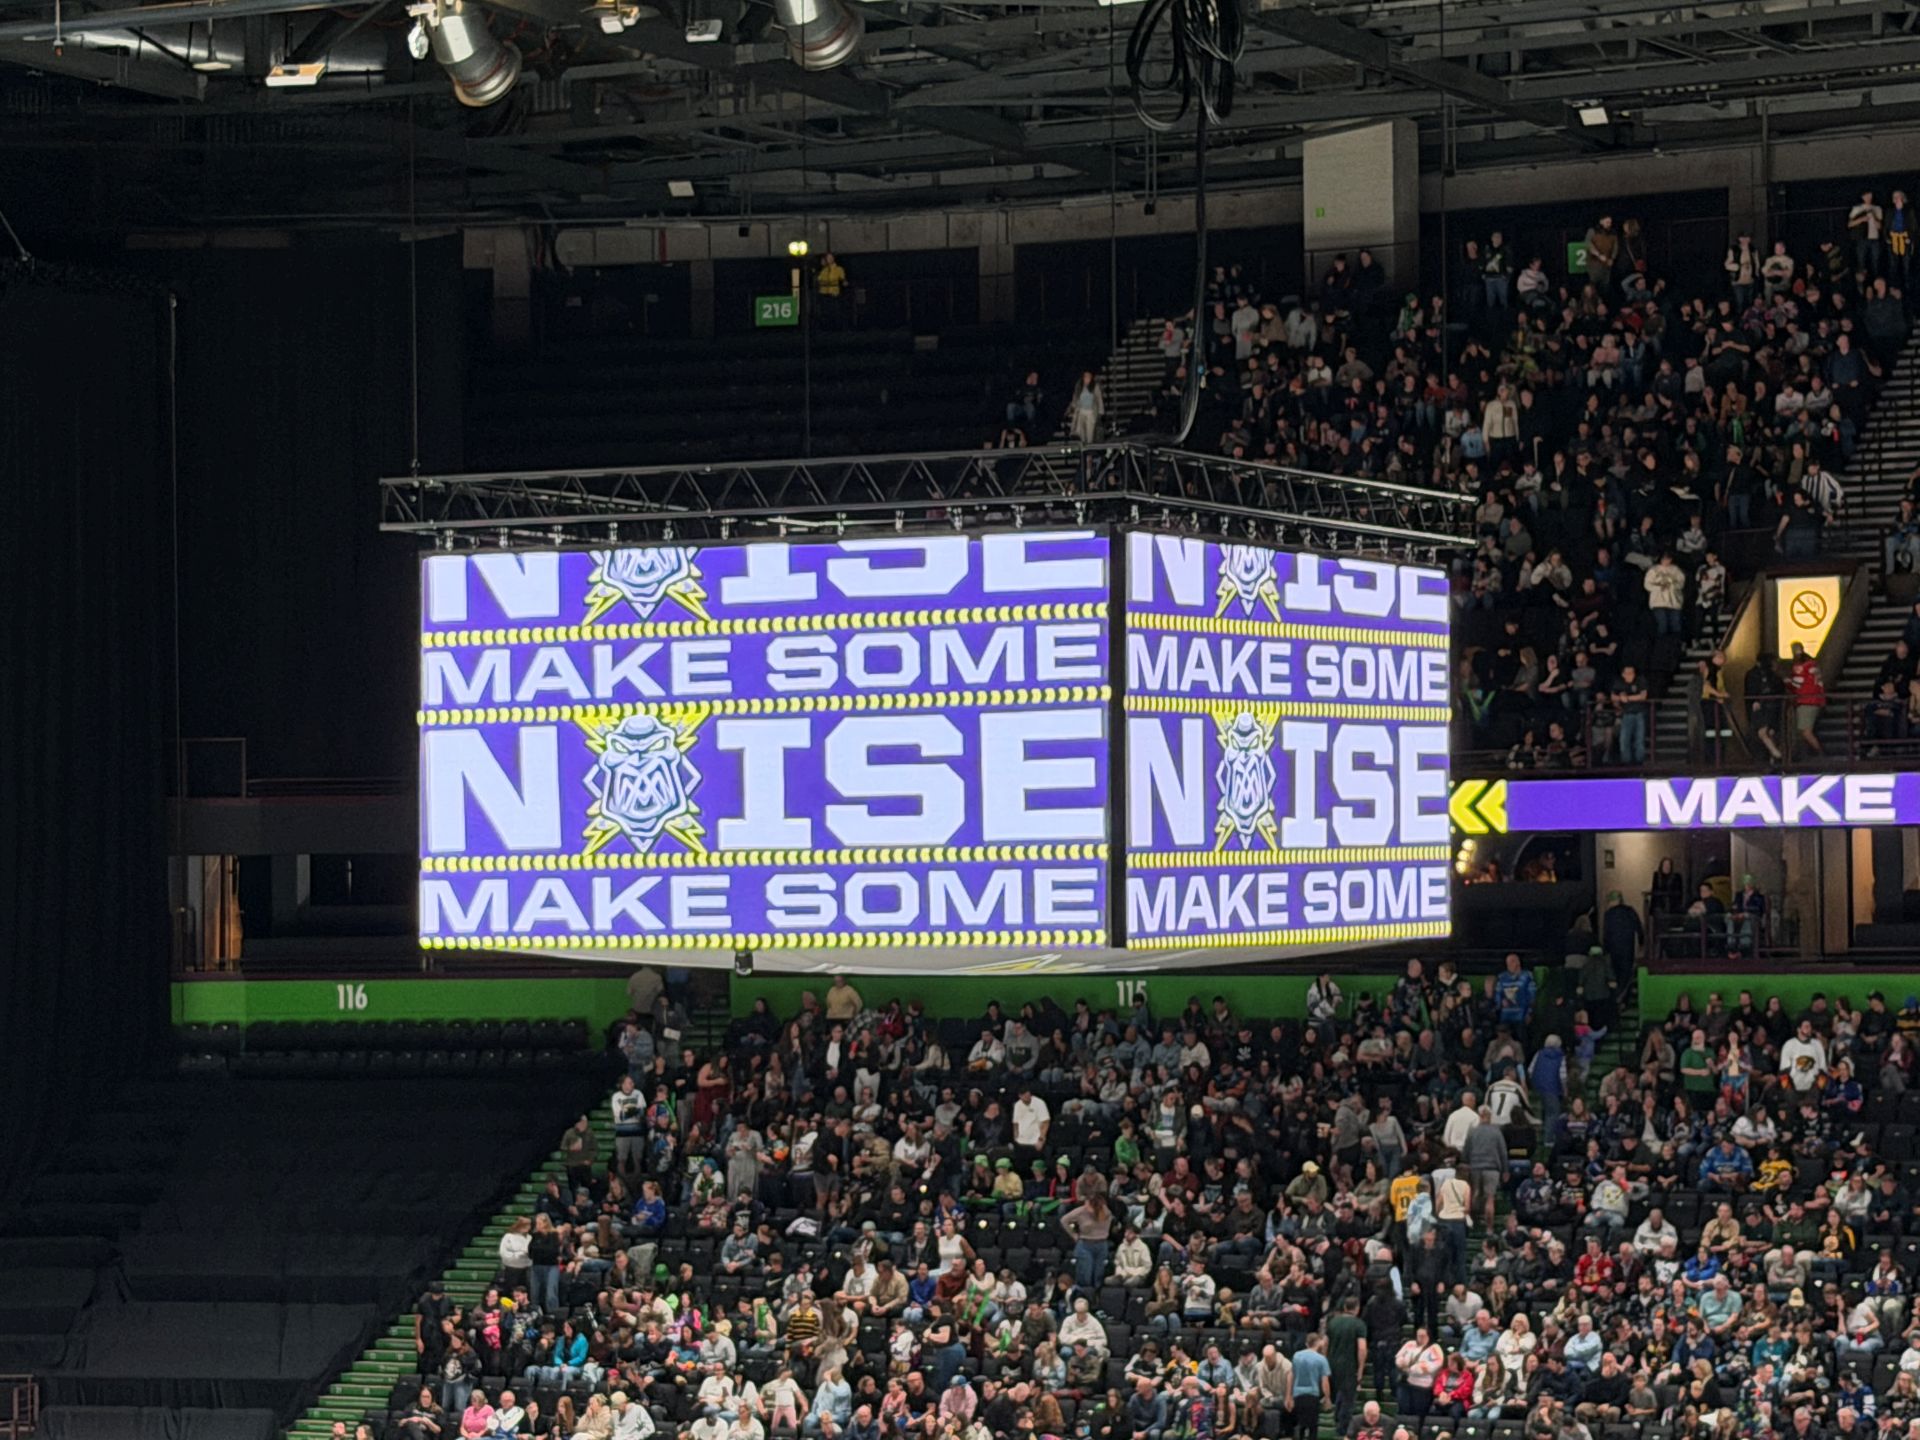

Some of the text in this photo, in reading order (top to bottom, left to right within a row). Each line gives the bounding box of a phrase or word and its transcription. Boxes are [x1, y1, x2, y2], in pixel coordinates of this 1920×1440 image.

[762, 303, 792, 319] 216
[426, 624, 1100, 705] MAKE SOME
[1128, 634, 1448, 701] MAKE SOME
[1645, 774, 1896, 824] MAKE
[422, 868, 1099, 933] MAKE SOME
[1128, 866, 1448, 933] MAKE SOME
[337, 984, 368, 1010] 116
[1116, 980, 1148, 1007] 115
